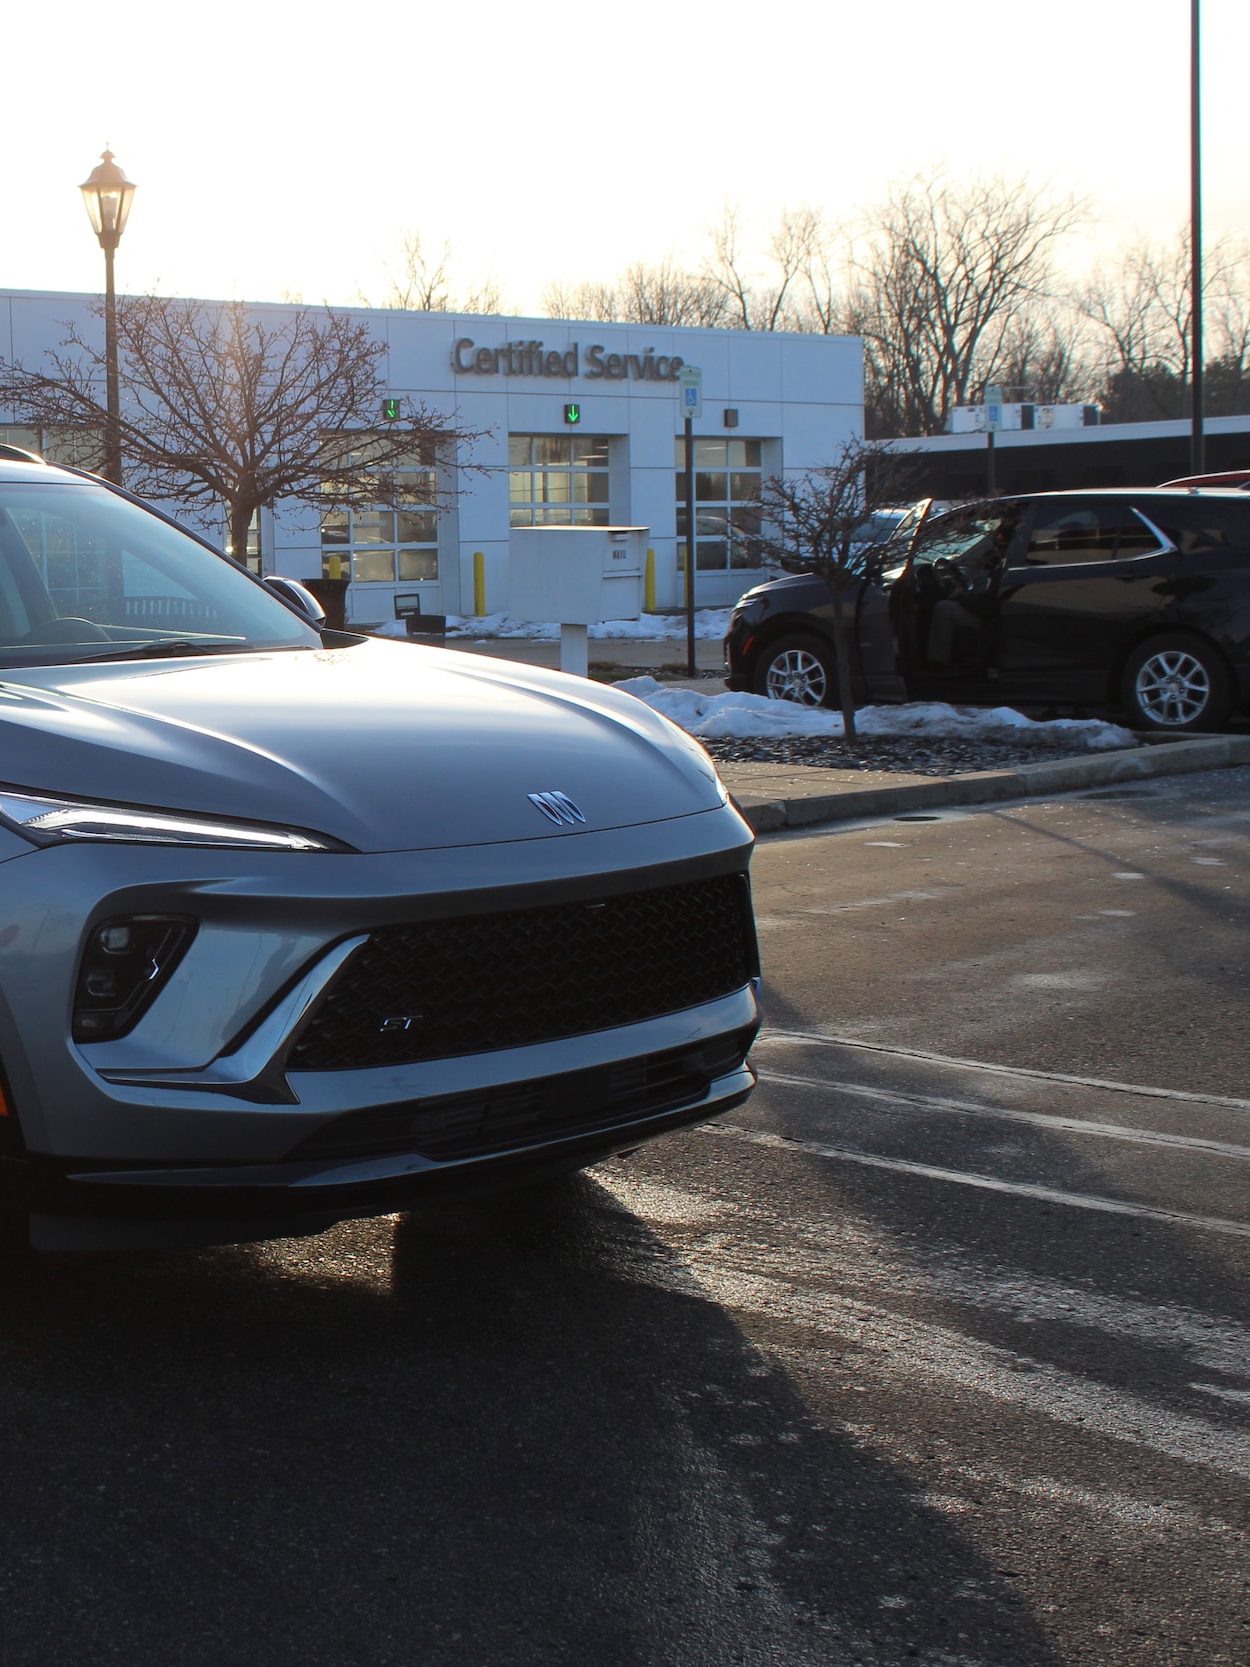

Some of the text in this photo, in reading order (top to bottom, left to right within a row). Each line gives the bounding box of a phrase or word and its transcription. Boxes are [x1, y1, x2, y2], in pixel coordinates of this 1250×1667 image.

[453, 337, 684, 381] Certified Service
[379, 1014, 423, 1032] ST
